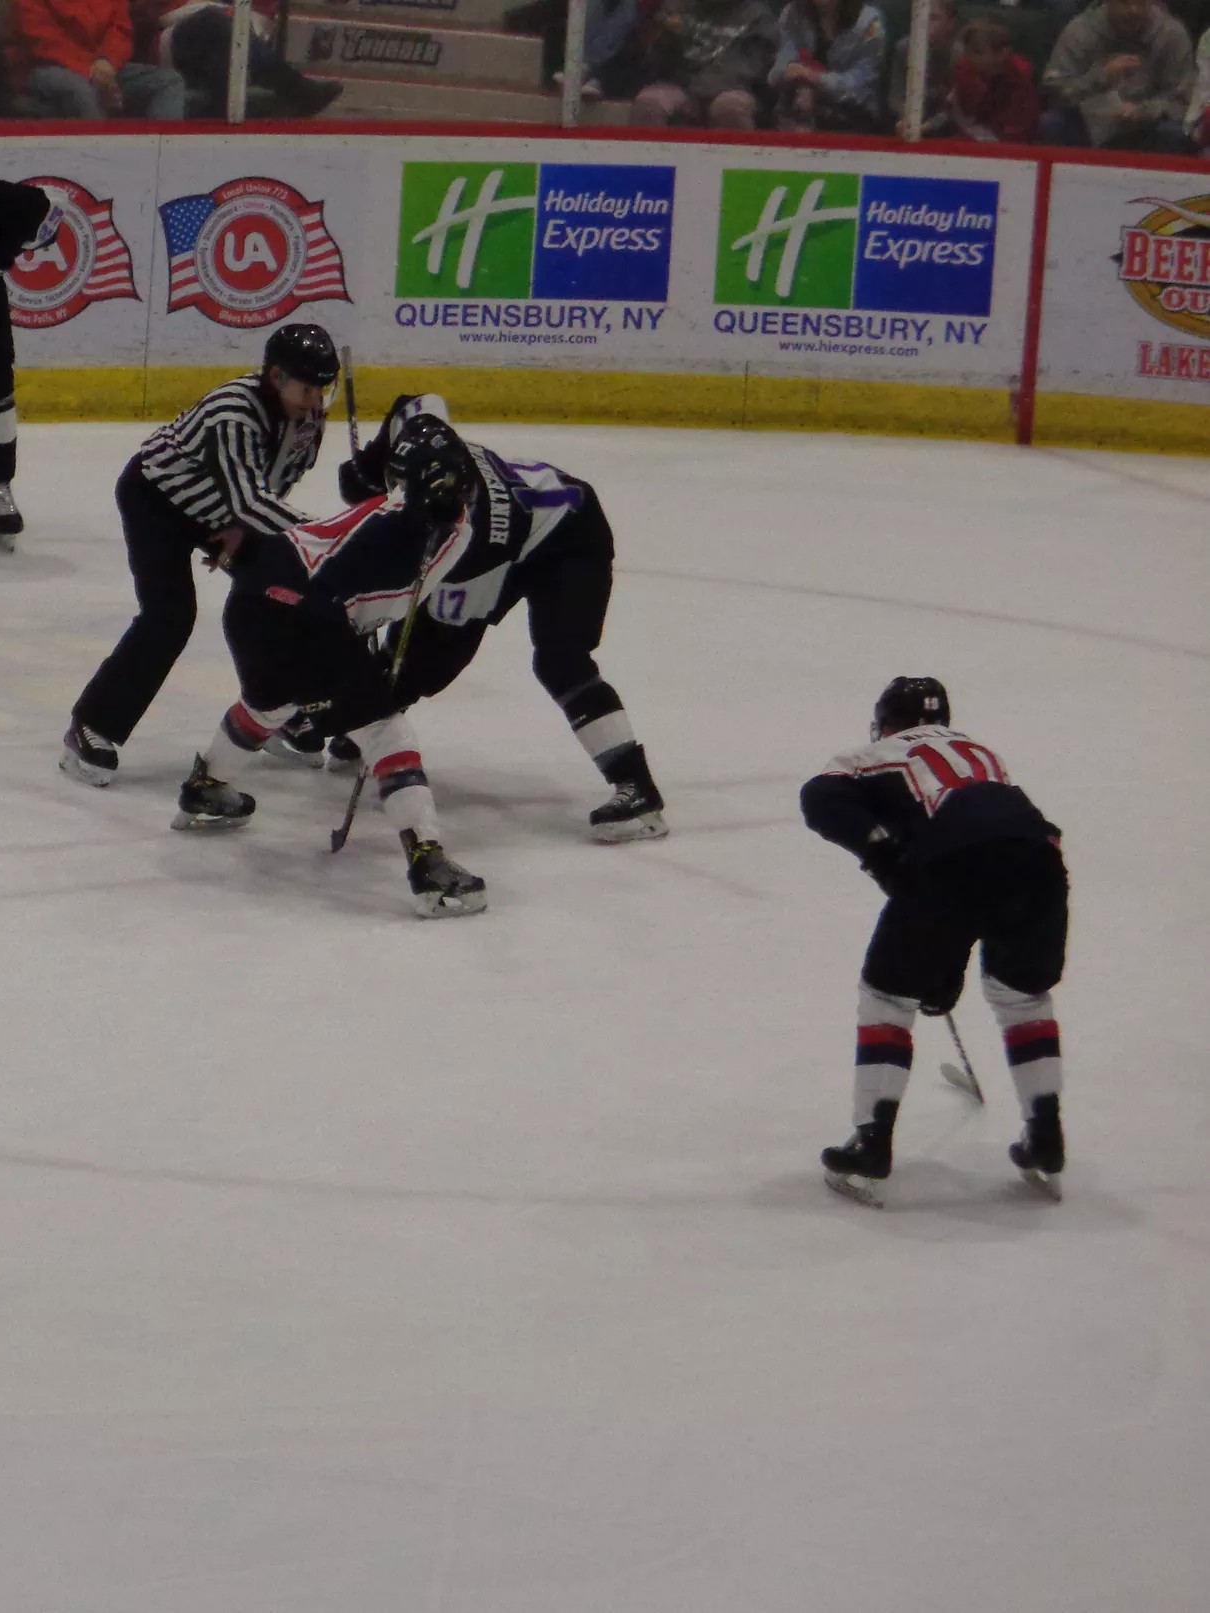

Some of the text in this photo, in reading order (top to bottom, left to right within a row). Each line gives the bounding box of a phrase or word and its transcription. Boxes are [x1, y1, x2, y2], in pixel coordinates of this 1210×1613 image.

[544, 190, 669, 219] Holiday Inn
[866, 200, 993, 232] Holiday Inn
[224, 232, 278, 272] UA
[542, 219, 664, 256] Express
[864, 230, 987, 270] Express
[395, 303, 665, 333] QUEENSBURY, NY
[713, 310, 988, 347] QUEENSBURY, NY
[459, 331, 598, 345] www.hiexpress.com
[779, 339, 919, 357] www.hiexpress.com
[436, 588, 467, 620] 17
